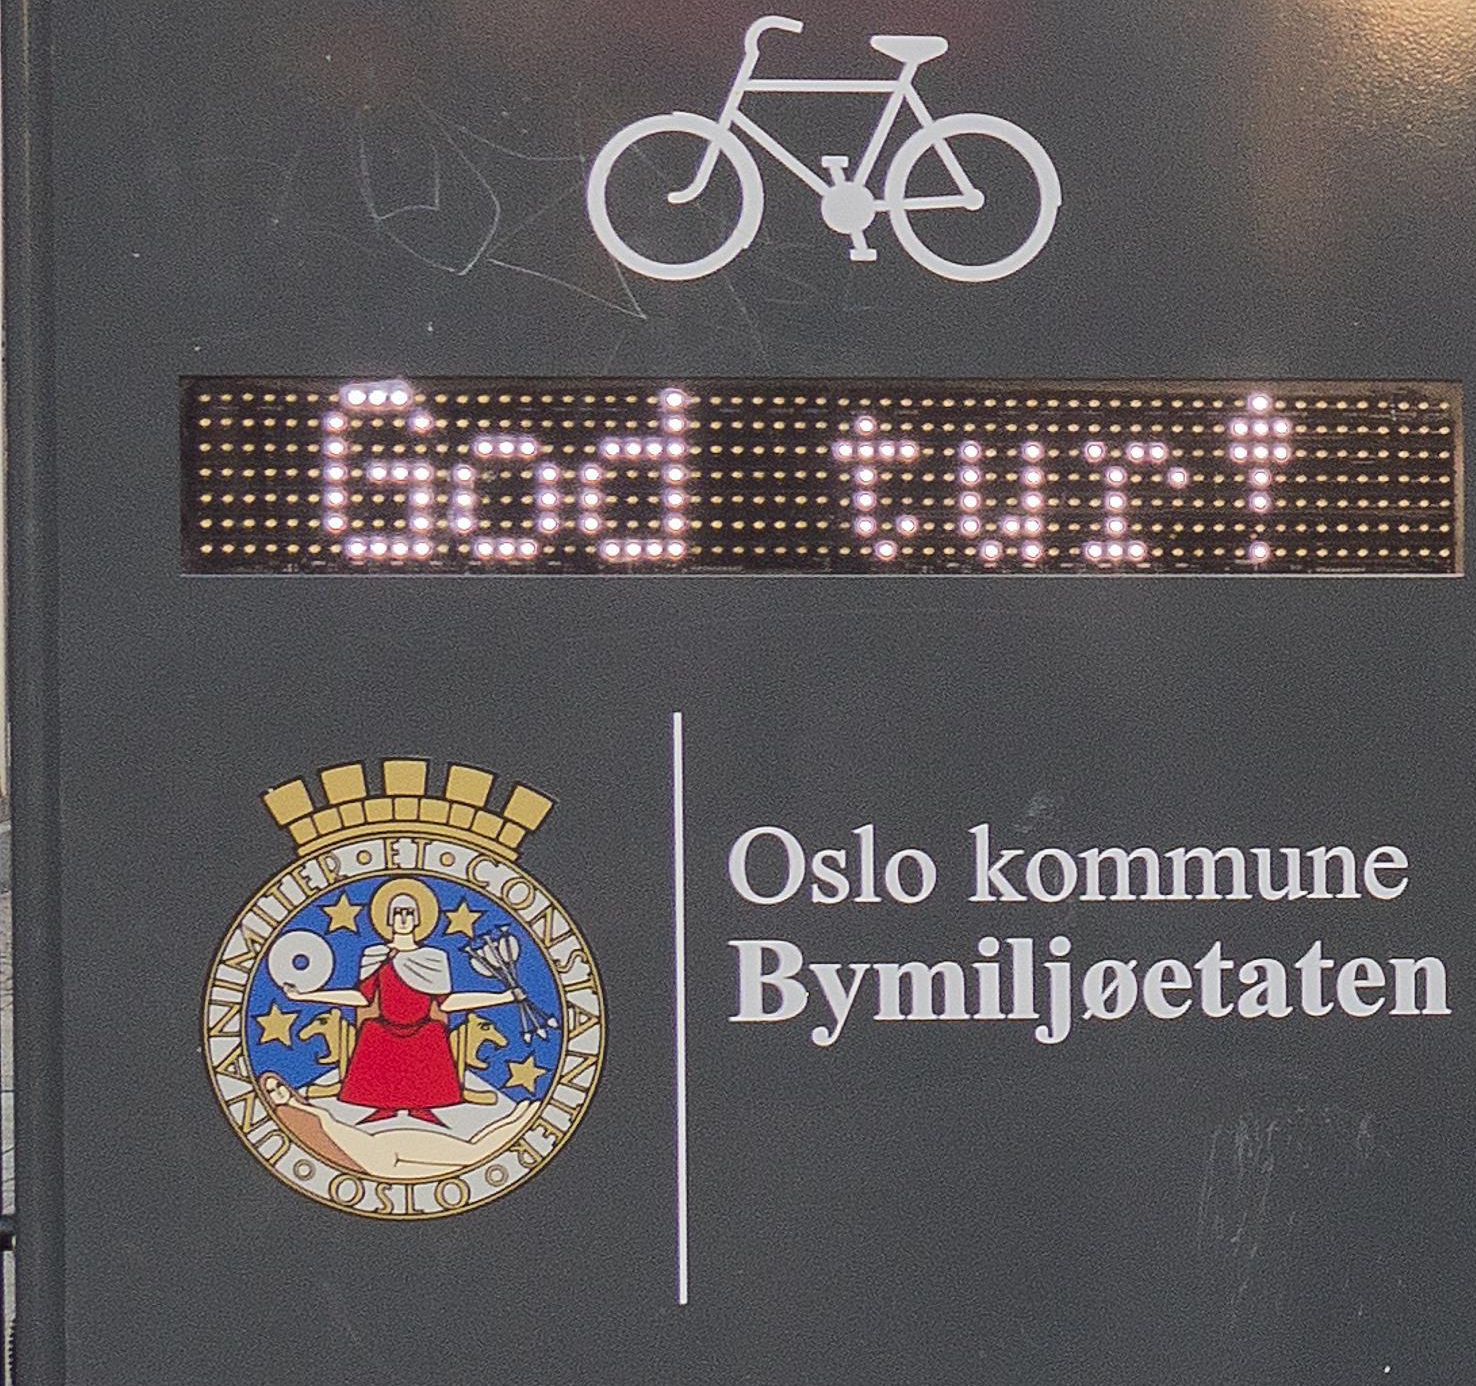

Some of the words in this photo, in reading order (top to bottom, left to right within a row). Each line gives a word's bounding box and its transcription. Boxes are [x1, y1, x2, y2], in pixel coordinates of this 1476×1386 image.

[322, 379, 690, 563] God
[831, 390, 1294, 564] tur!
[728, 823, 938, 905] Oslo
[967, 823, 1411, 904] kommune
[728, 934, 1453, 1048] Bymiljøetaten
[327, 1172, 471, 1216] OSLO
